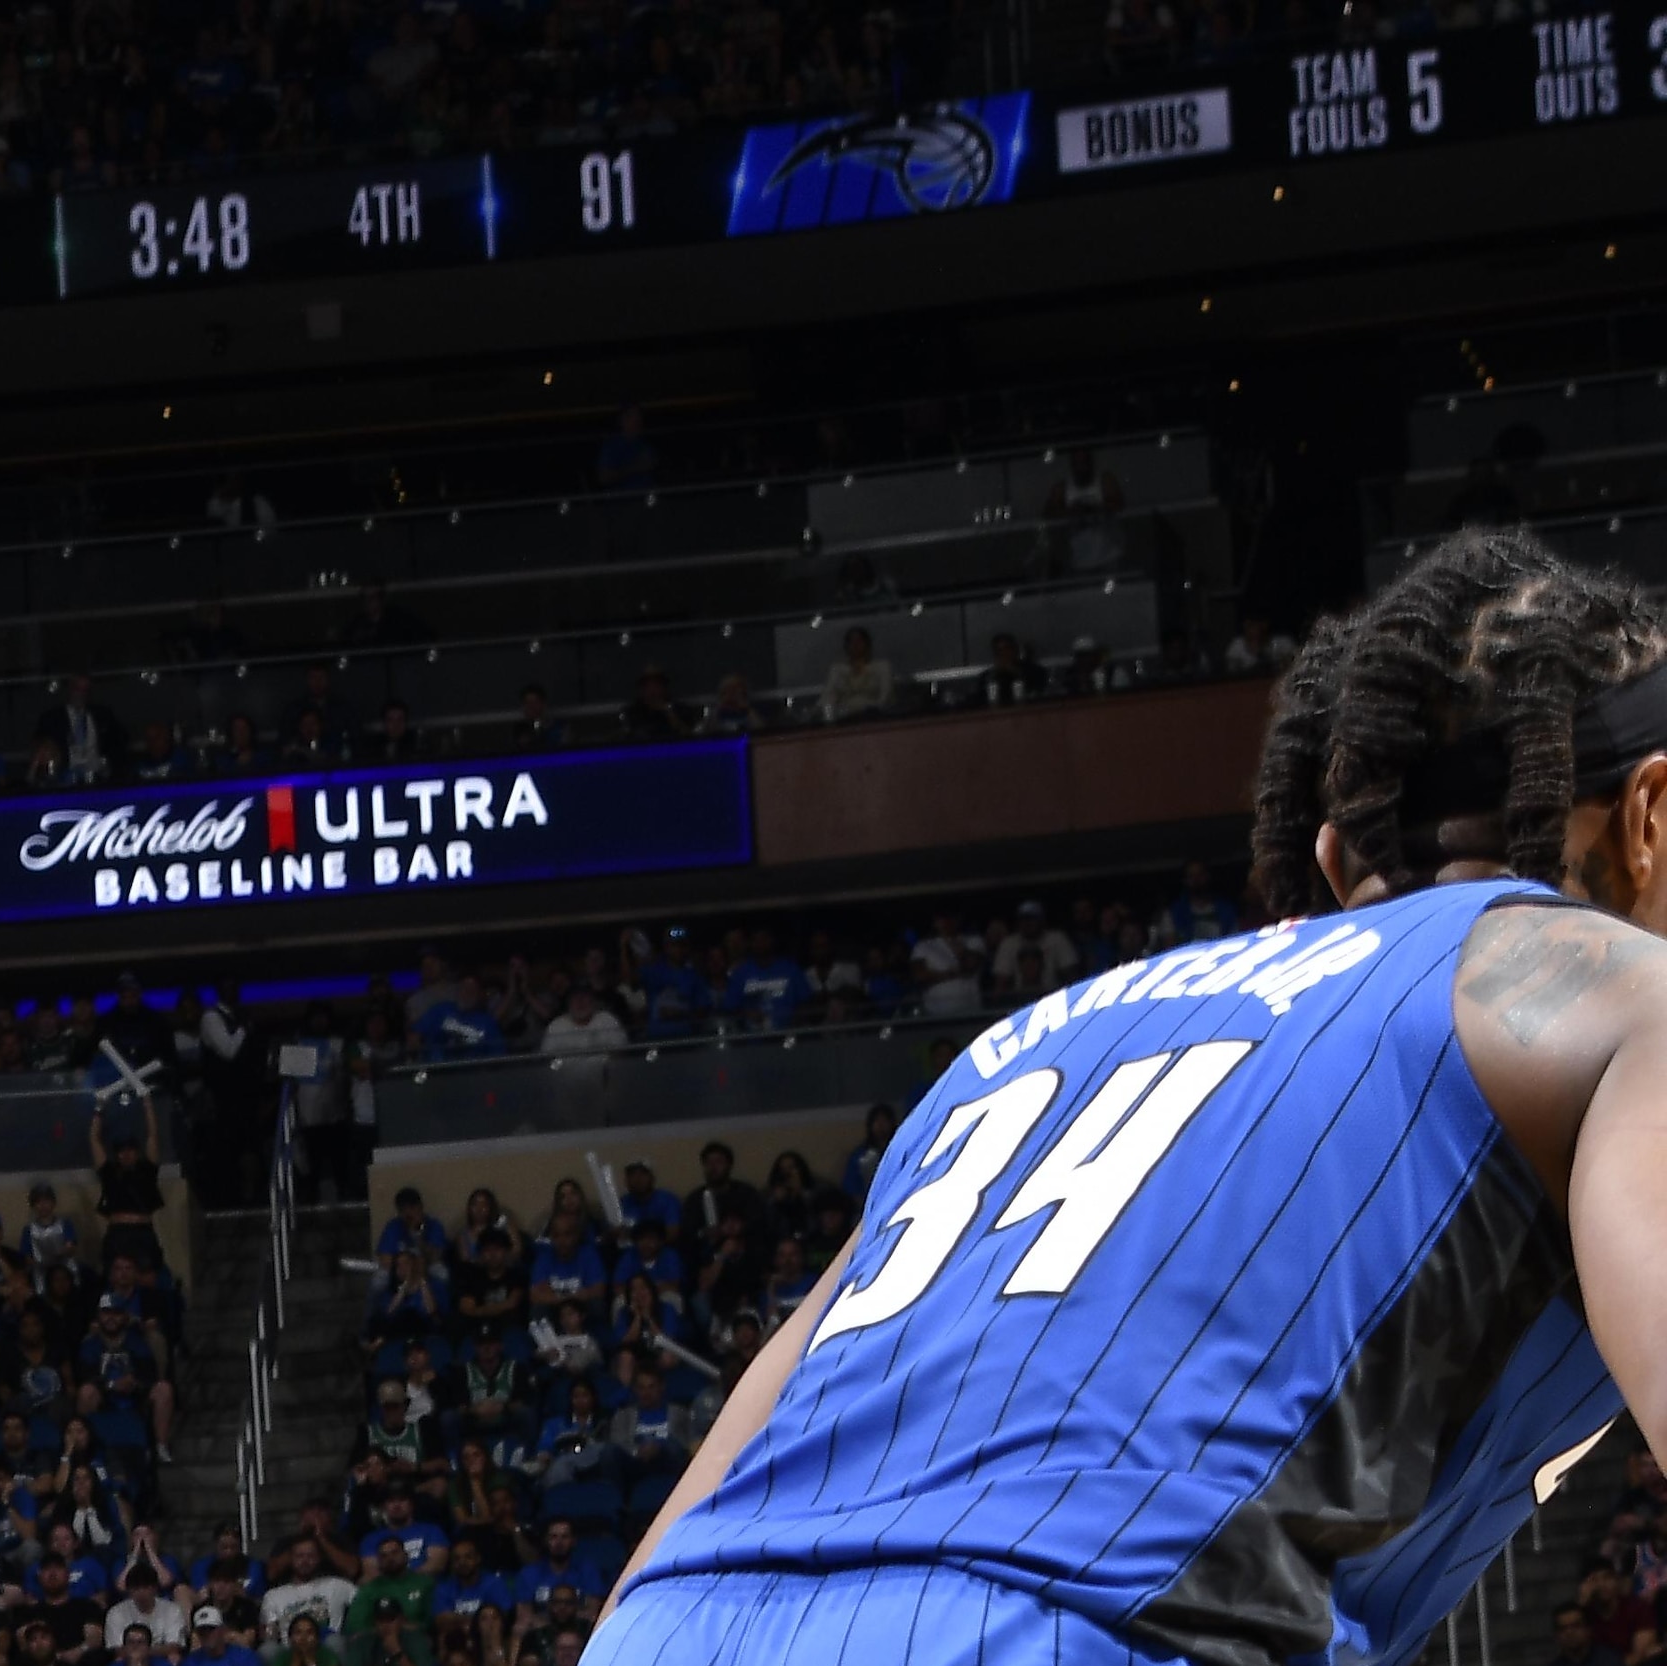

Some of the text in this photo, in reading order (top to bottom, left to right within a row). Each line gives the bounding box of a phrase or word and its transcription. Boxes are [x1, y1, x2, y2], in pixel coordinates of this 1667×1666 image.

[1532, 14, 1613, 68] TIME
[1291, 47, 1377, 102] TEAM
[1406, 48, 1443, 135] 5
[1533, 67, 1619, 122] OUTS
[1087, 103, 1199, 161] BONUS
[1288, 96, 1388, 158] FOULS
[348, 183, 421, 246] 4TH
[580, 151, 637, 232] 91
[130, 193, 250, 279] 3:48
[19, 772, 549, 872] Michelob ULTRA
[93, 842, 475, 906] BASELINE BAR
[807, 1040, 1259, 1356] 34
